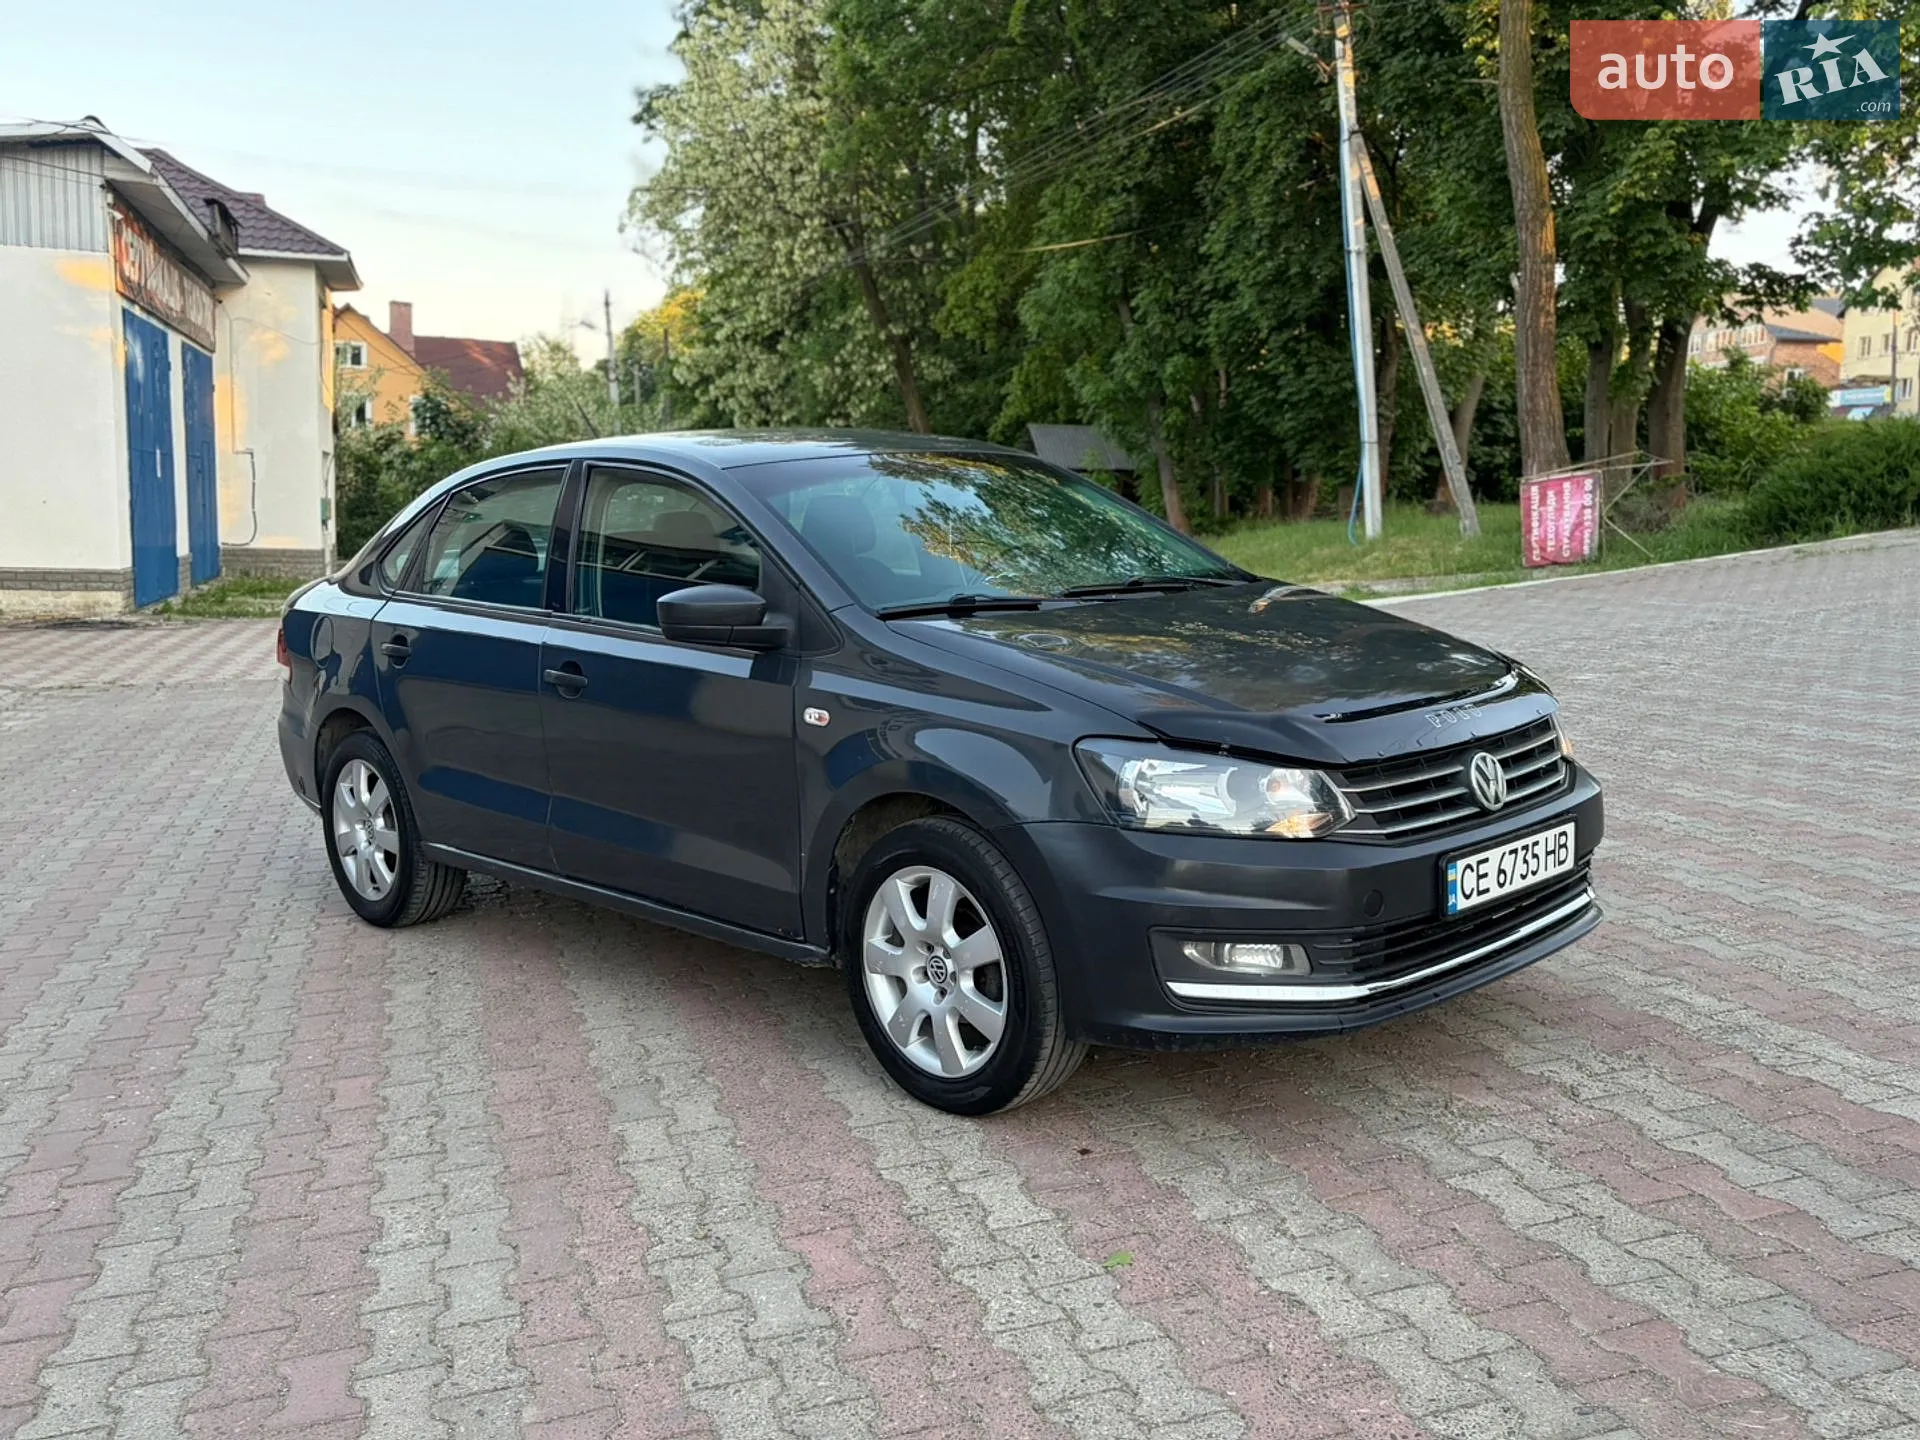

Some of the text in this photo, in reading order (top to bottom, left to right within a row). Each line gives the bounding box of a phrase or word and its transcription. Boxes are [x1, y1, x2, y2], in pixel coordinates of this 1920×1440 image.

[1460, 830, 1569, 900] CE 6735 HB
